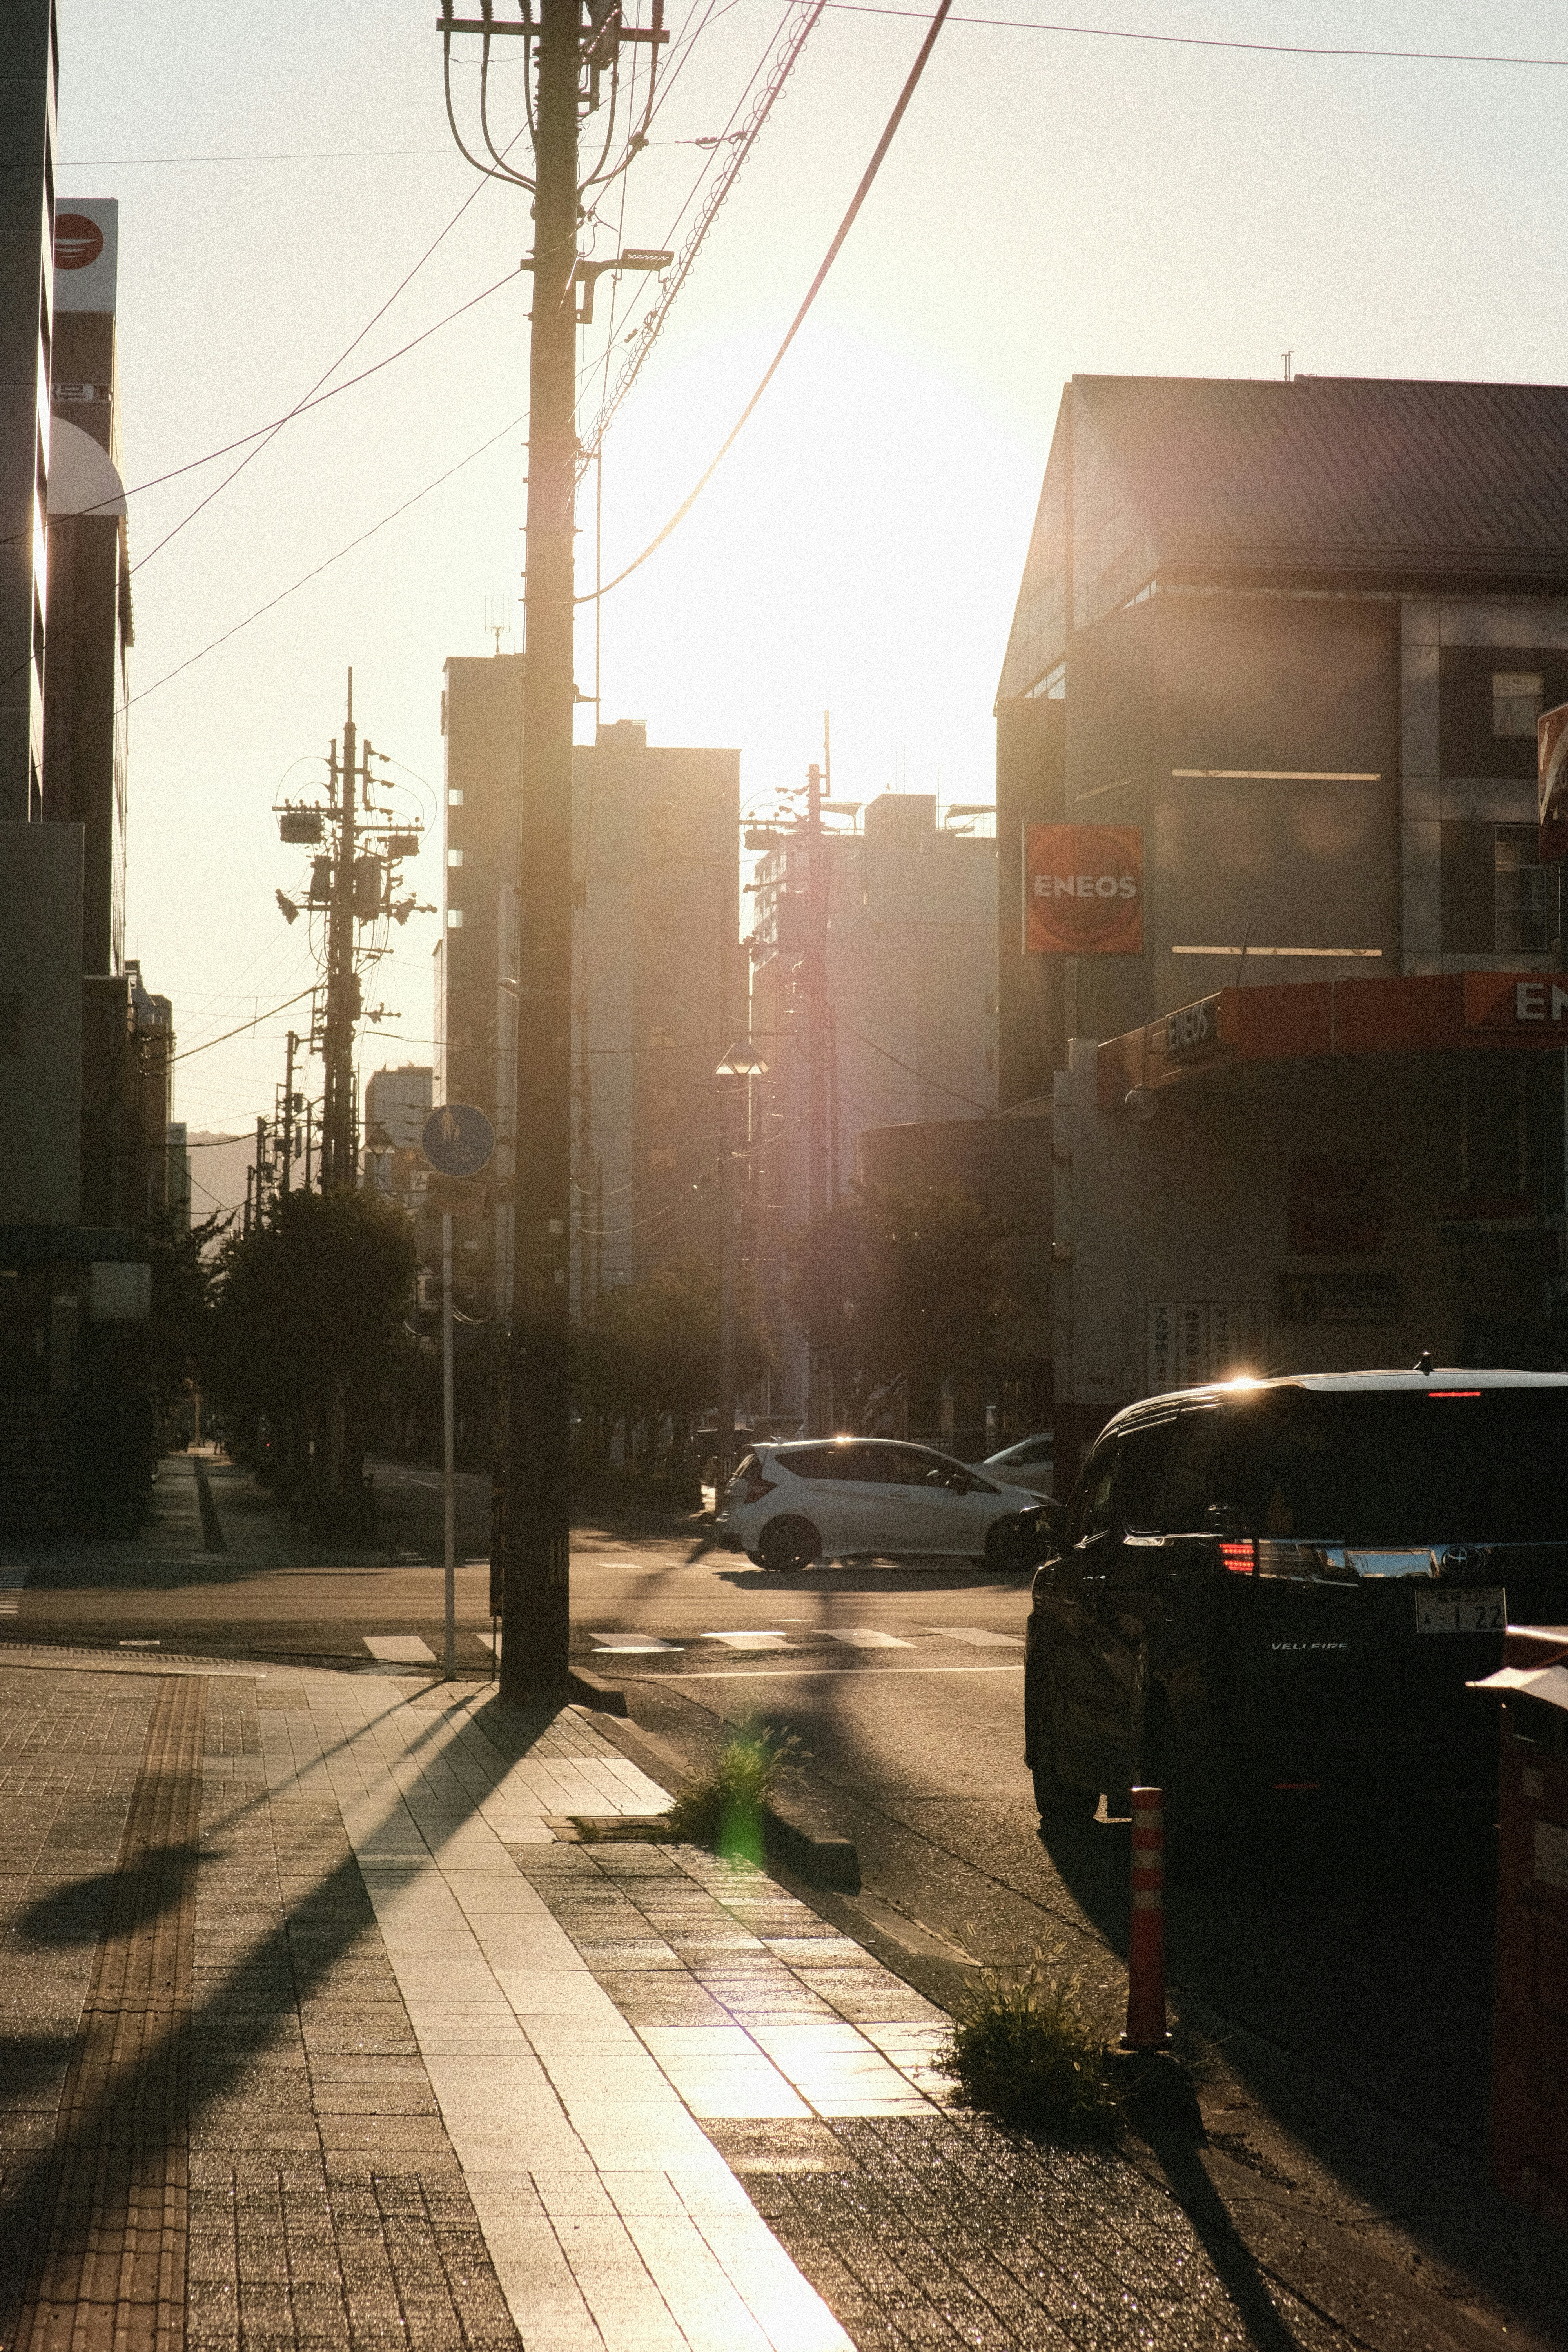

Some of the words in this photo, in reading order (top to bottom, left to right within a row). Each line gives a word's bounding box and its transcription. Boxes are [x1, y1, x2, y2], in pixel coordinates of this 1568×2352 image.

[1034, 875, 1137, 898] ENEOS
[1168, 1002, 1208, 1051] ENEOS
[1271, 1642, 1348, 1651] VELLFIRE
